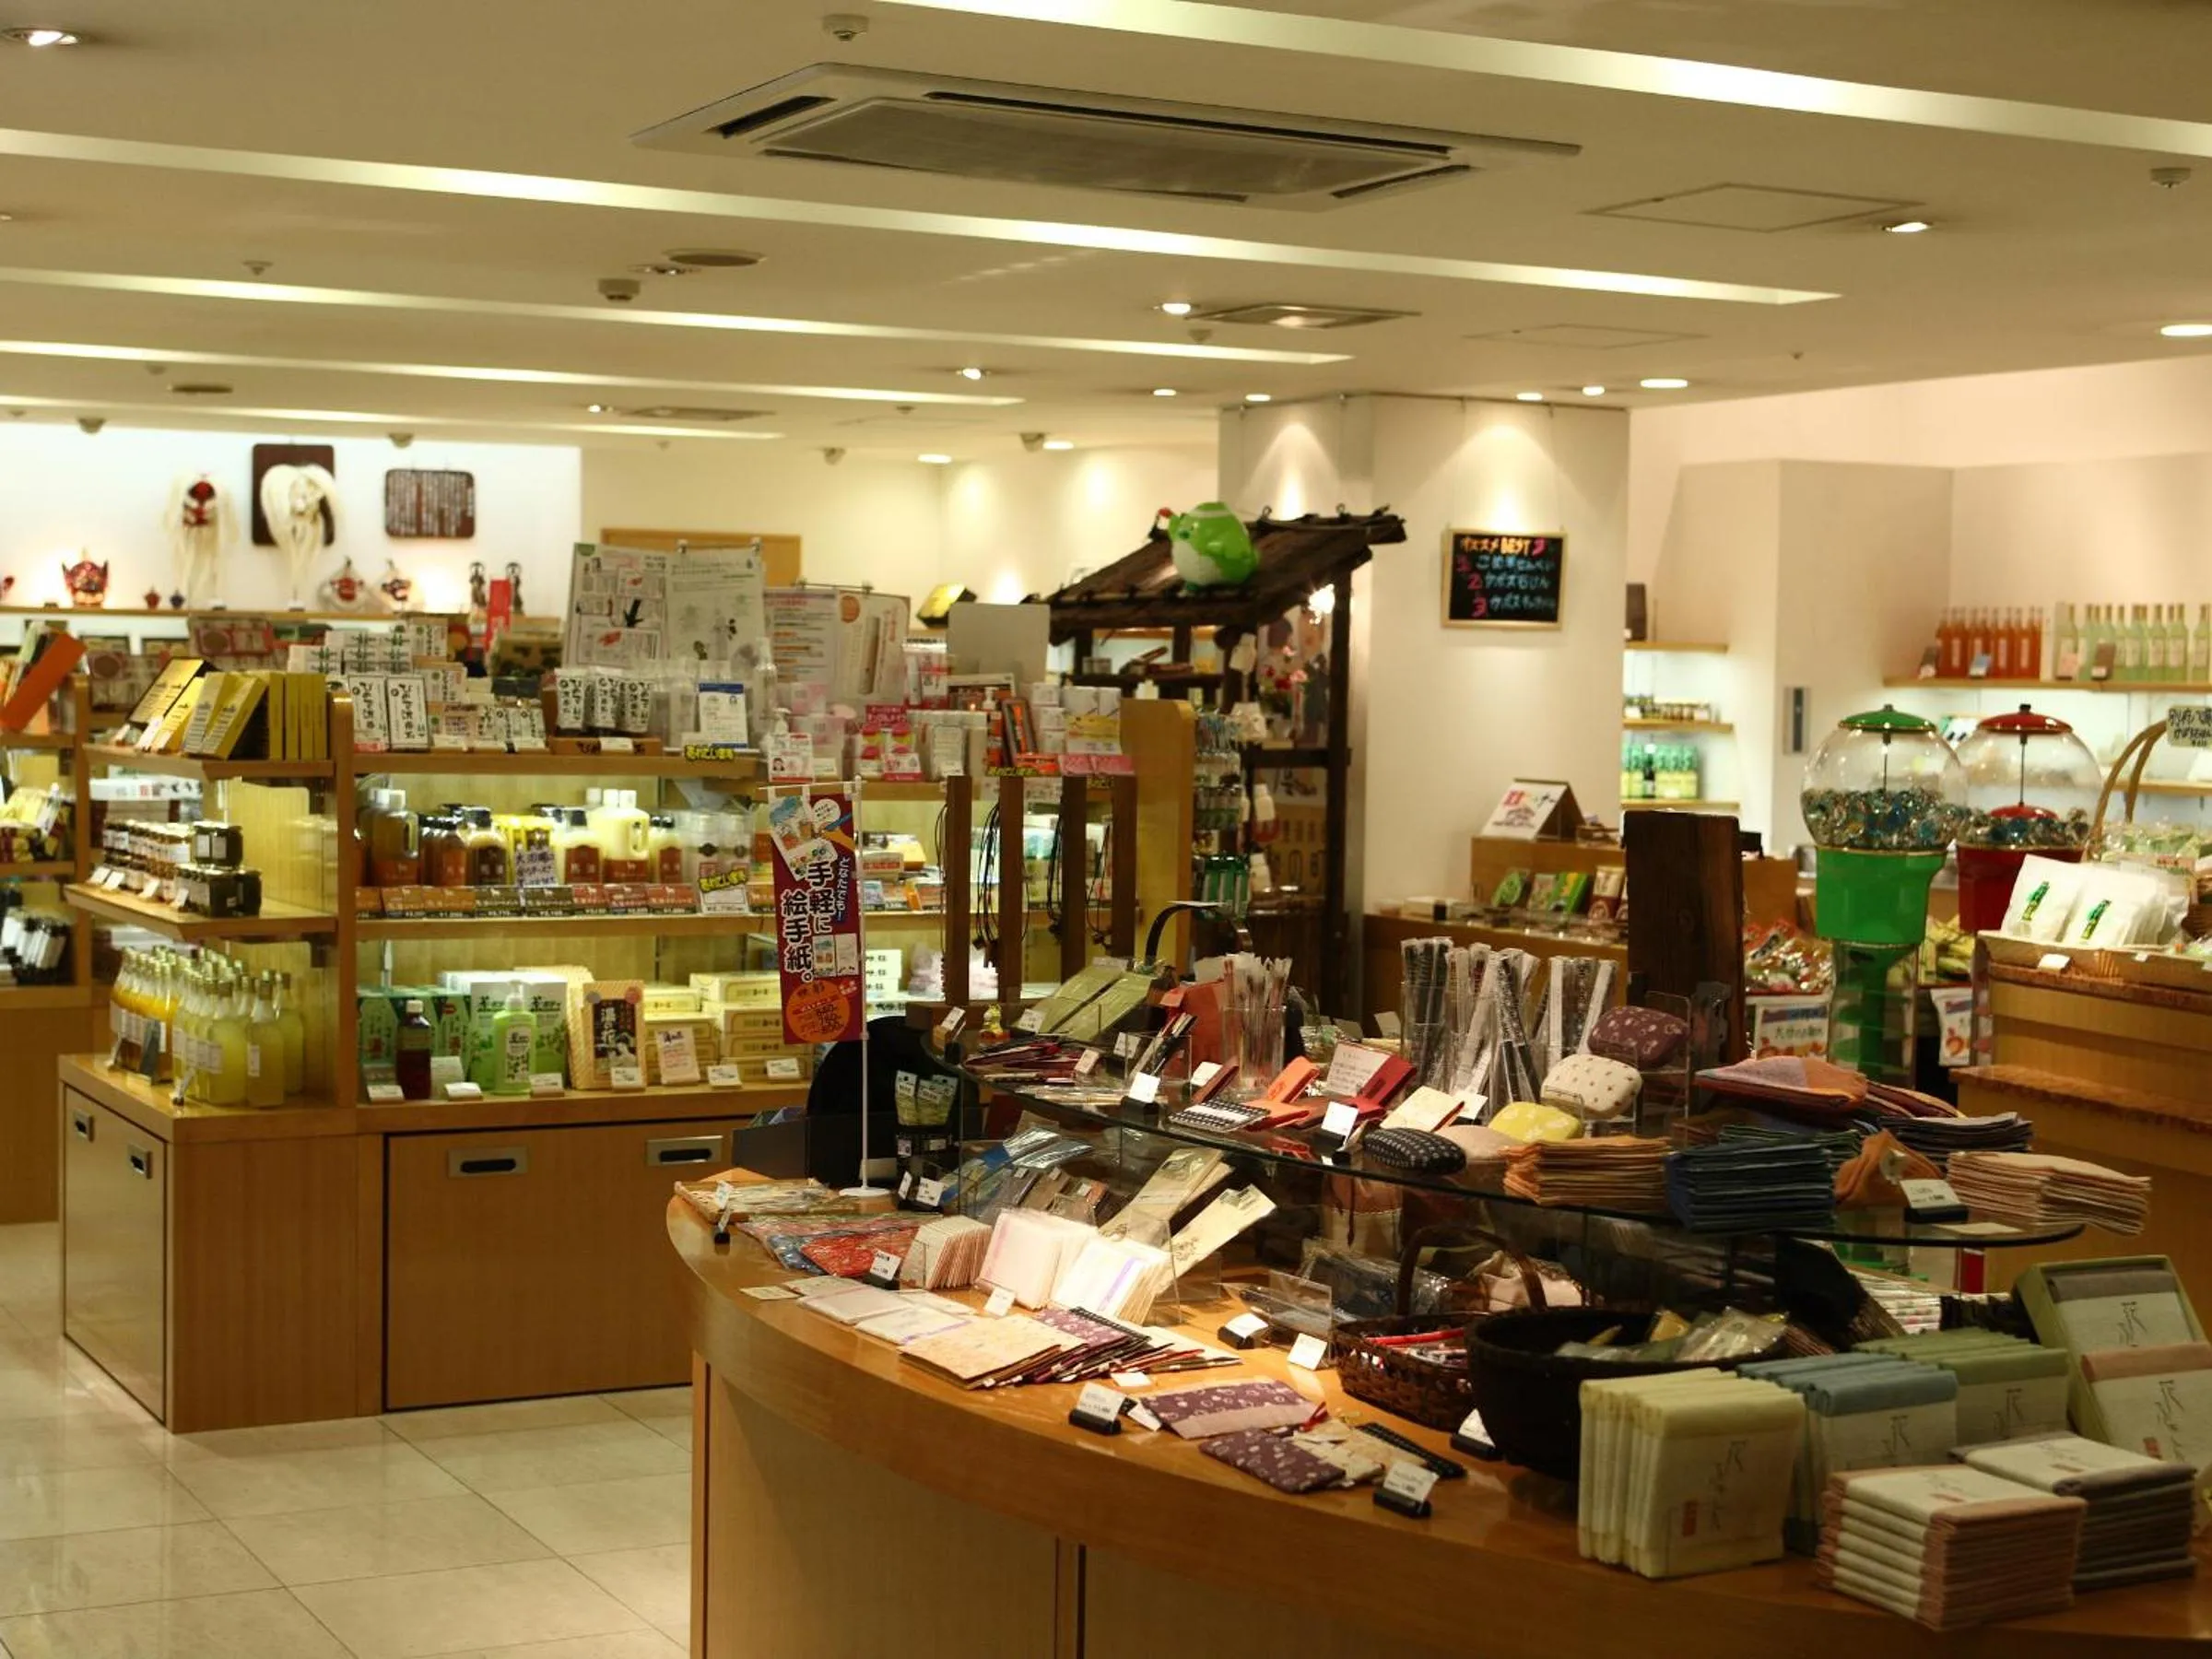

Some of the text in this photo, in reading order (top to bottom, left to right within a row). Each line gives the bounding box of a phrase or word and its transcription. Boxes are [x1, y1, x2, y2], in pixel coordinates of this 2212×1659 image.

[1467, 572, 1483, 590] 2
[1471, 596, 1488, 618] 3
[806, 860, 835, 934] 手軽に
[782, 889, 815, 982] 絵手紙。
